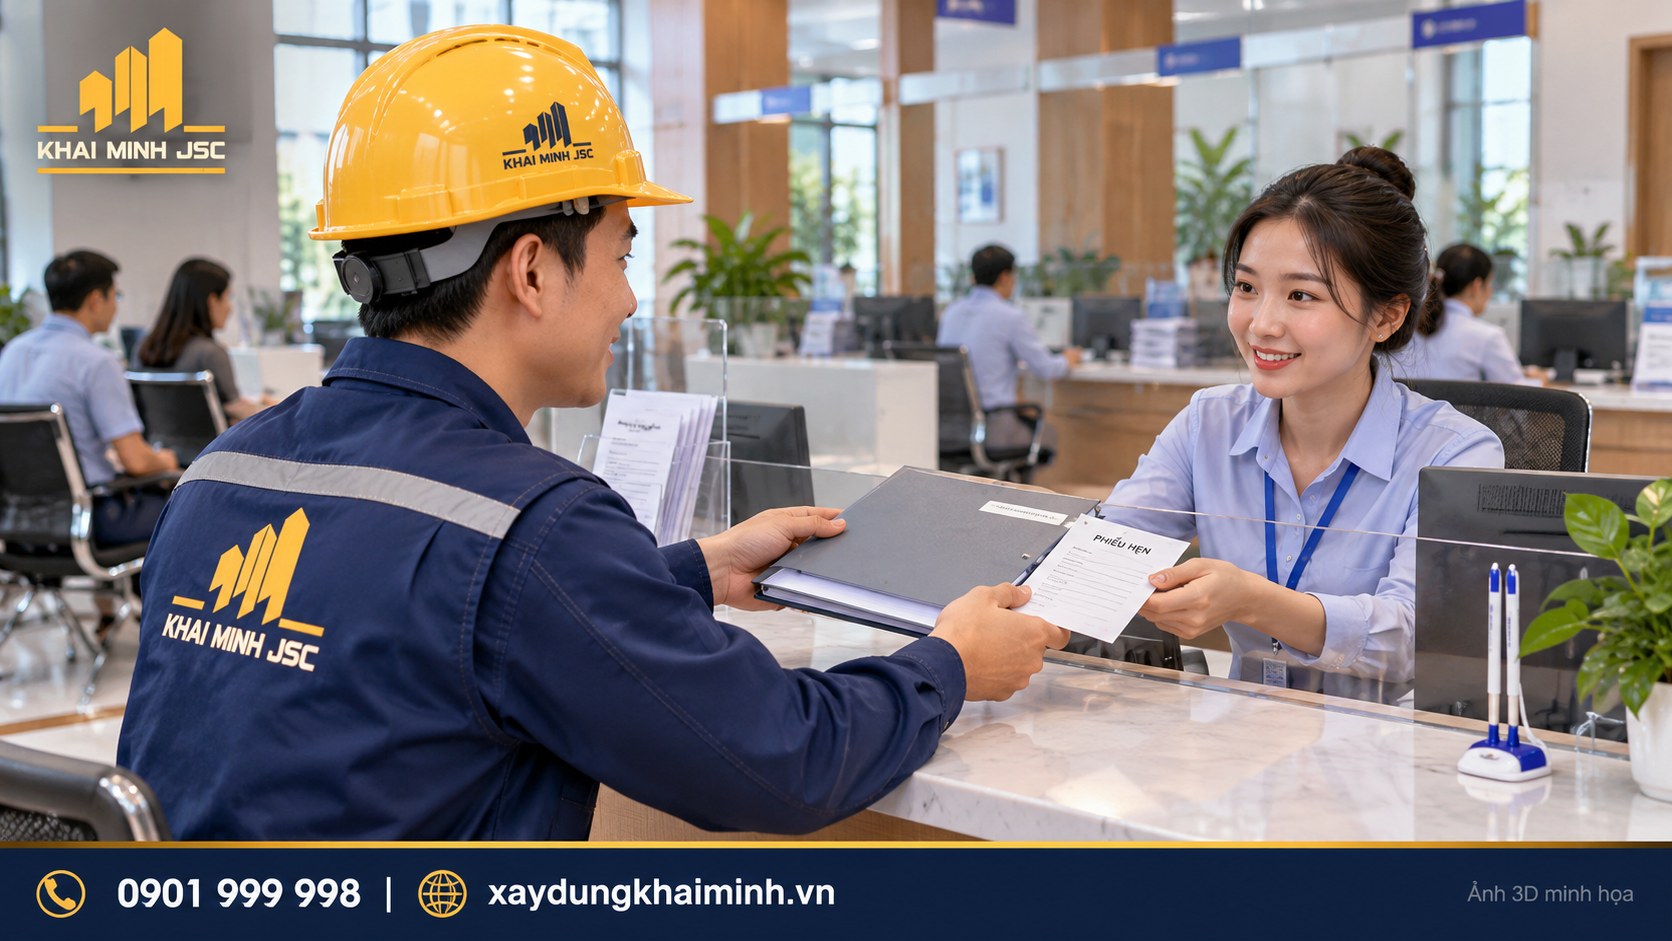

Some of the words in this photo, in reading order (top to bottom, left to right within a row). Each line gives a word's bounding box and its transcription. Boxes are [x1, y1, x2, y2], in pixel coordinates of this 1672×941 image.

[503, 155, 536, 170] KHAI
[539, 151, 571, 165] MINH
[573, 149, 594, 160] JSC
[1093, 534, 1126, 548] PHIẾU
[162, 613, 211, 645] KHAI
[210, 624, 266, 658] MINH
[266, 638, 320, 672] JSC
